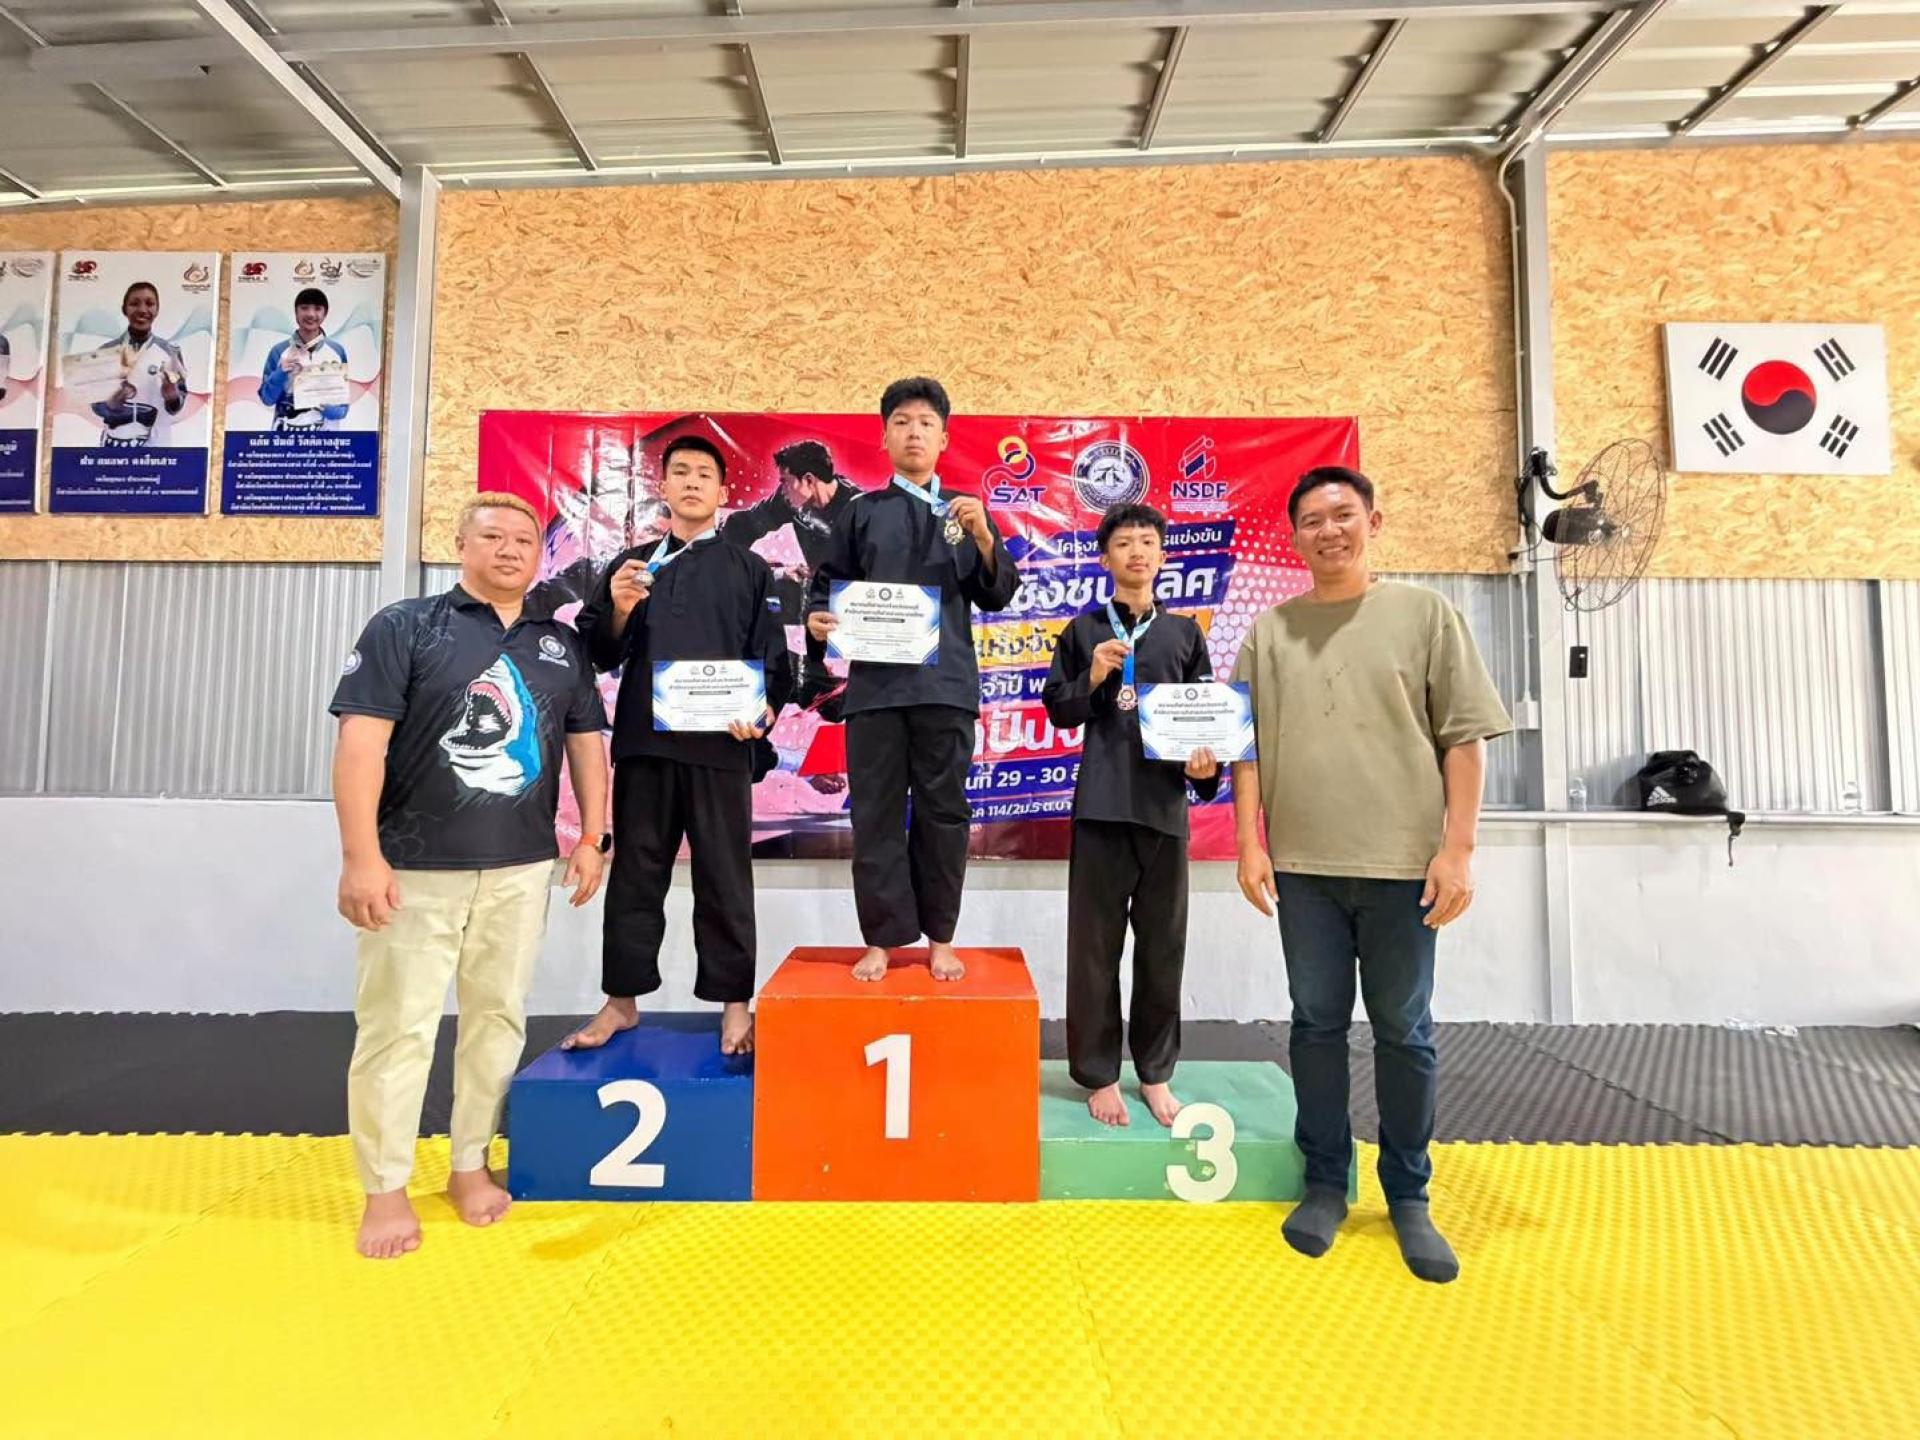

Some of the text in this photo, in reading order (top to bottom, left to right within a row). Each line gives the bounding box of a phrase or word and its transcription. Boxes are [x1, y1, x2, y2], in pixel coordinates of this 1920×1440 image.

[990, 487, 1046, 503] SAT
[1173, 482, 1227, 498] NSDF
[996, 769, 1022, 788] 29
[1040, 766, 1067, 784] 30
[864, 1034, 912, 1140] 1
[589, 1080, 667, 1188] 2
[1166, 1103, 1239, 1203] 3
